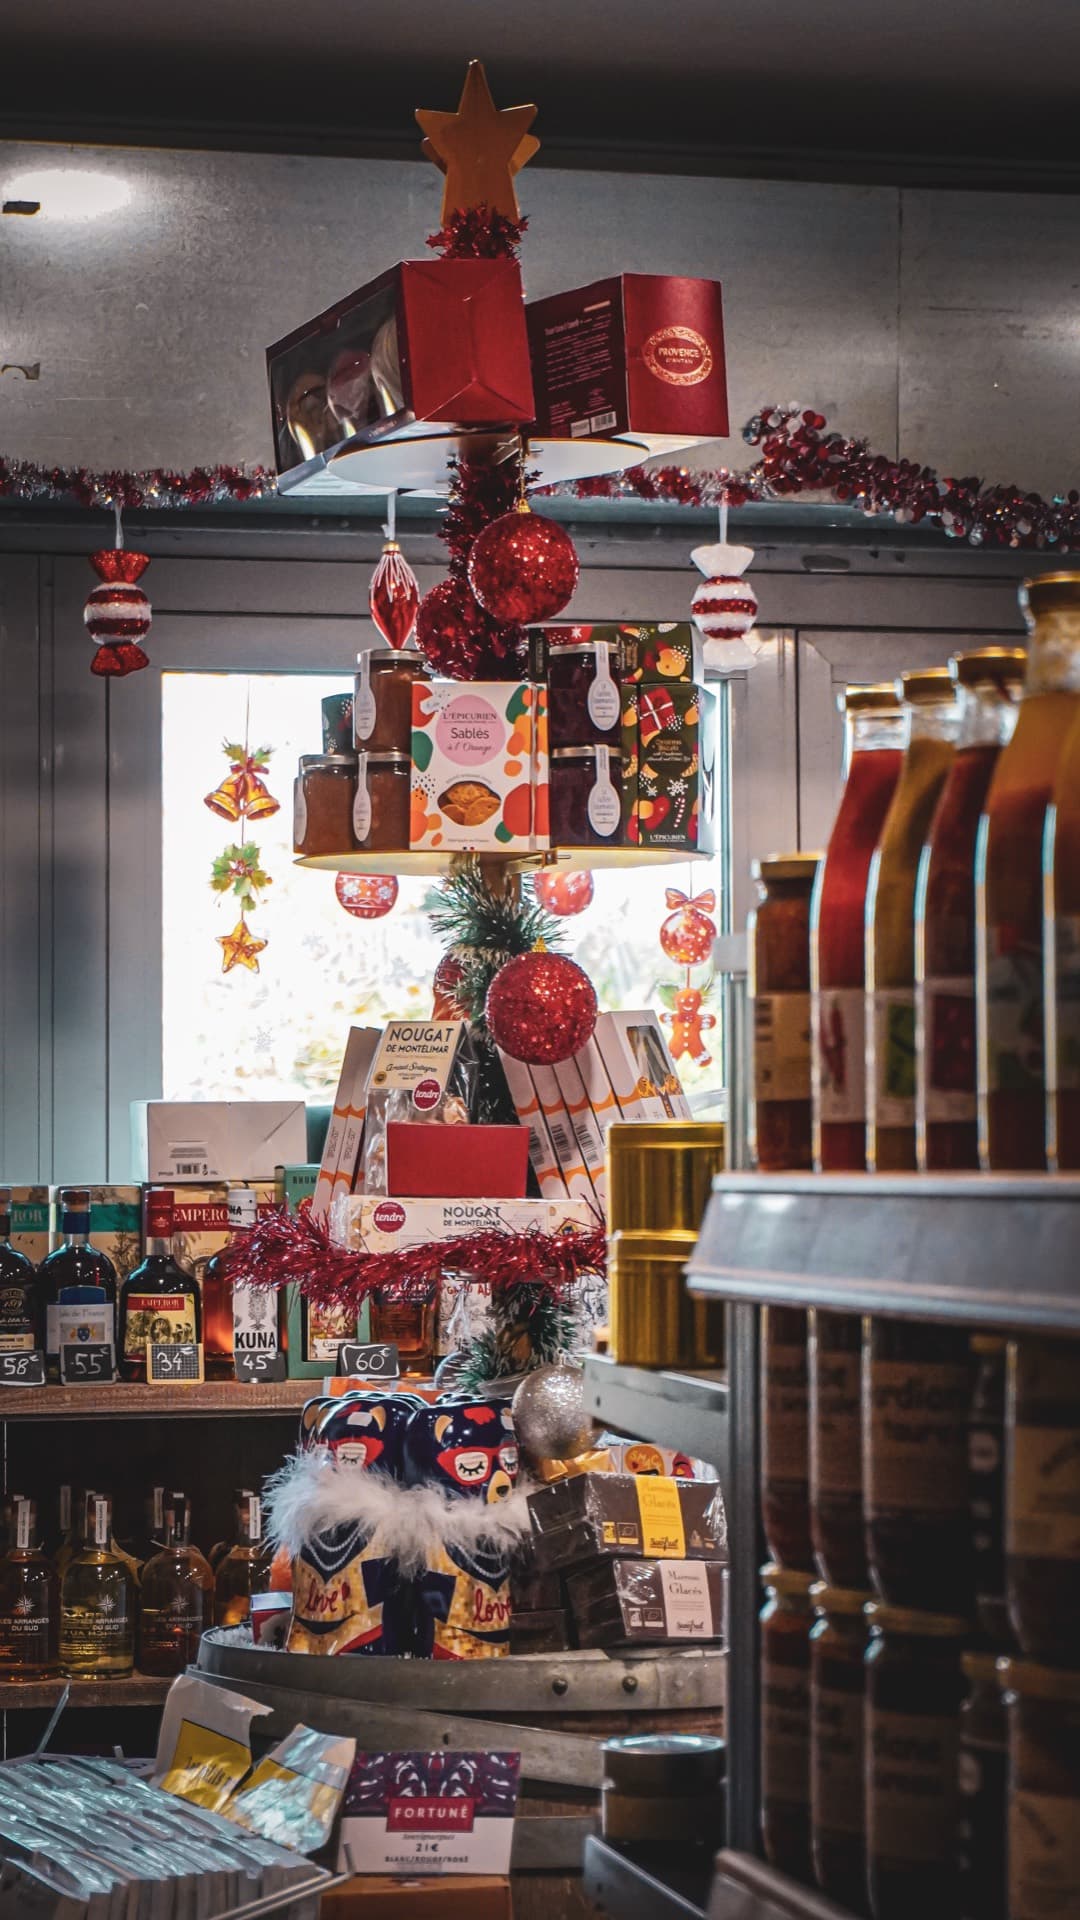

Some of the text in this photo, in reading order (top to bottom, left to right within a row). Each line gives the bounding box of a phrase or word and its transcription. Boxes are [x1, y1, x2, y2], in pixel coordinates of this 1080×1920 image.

[658, 347, 700, 358] PROVENCE
[450, 727, 490, 739] Sablés
[389, 1027, 455, 1042] NOUGAT
[386, 1044, 398, 1053] DE
[415, 1089, 440, 1099] tendre
[173, 1208, 230, 1221] EMPERO
[375, 1211, 406, 1223] tendre
[443, 1206, 501, 1218] NOUGAT
[443, 1219, 454, 1227] DE
[235, 1332, 276, 1349] KUNA
[394, 1804, 469, 1819] FORTUNÉ
